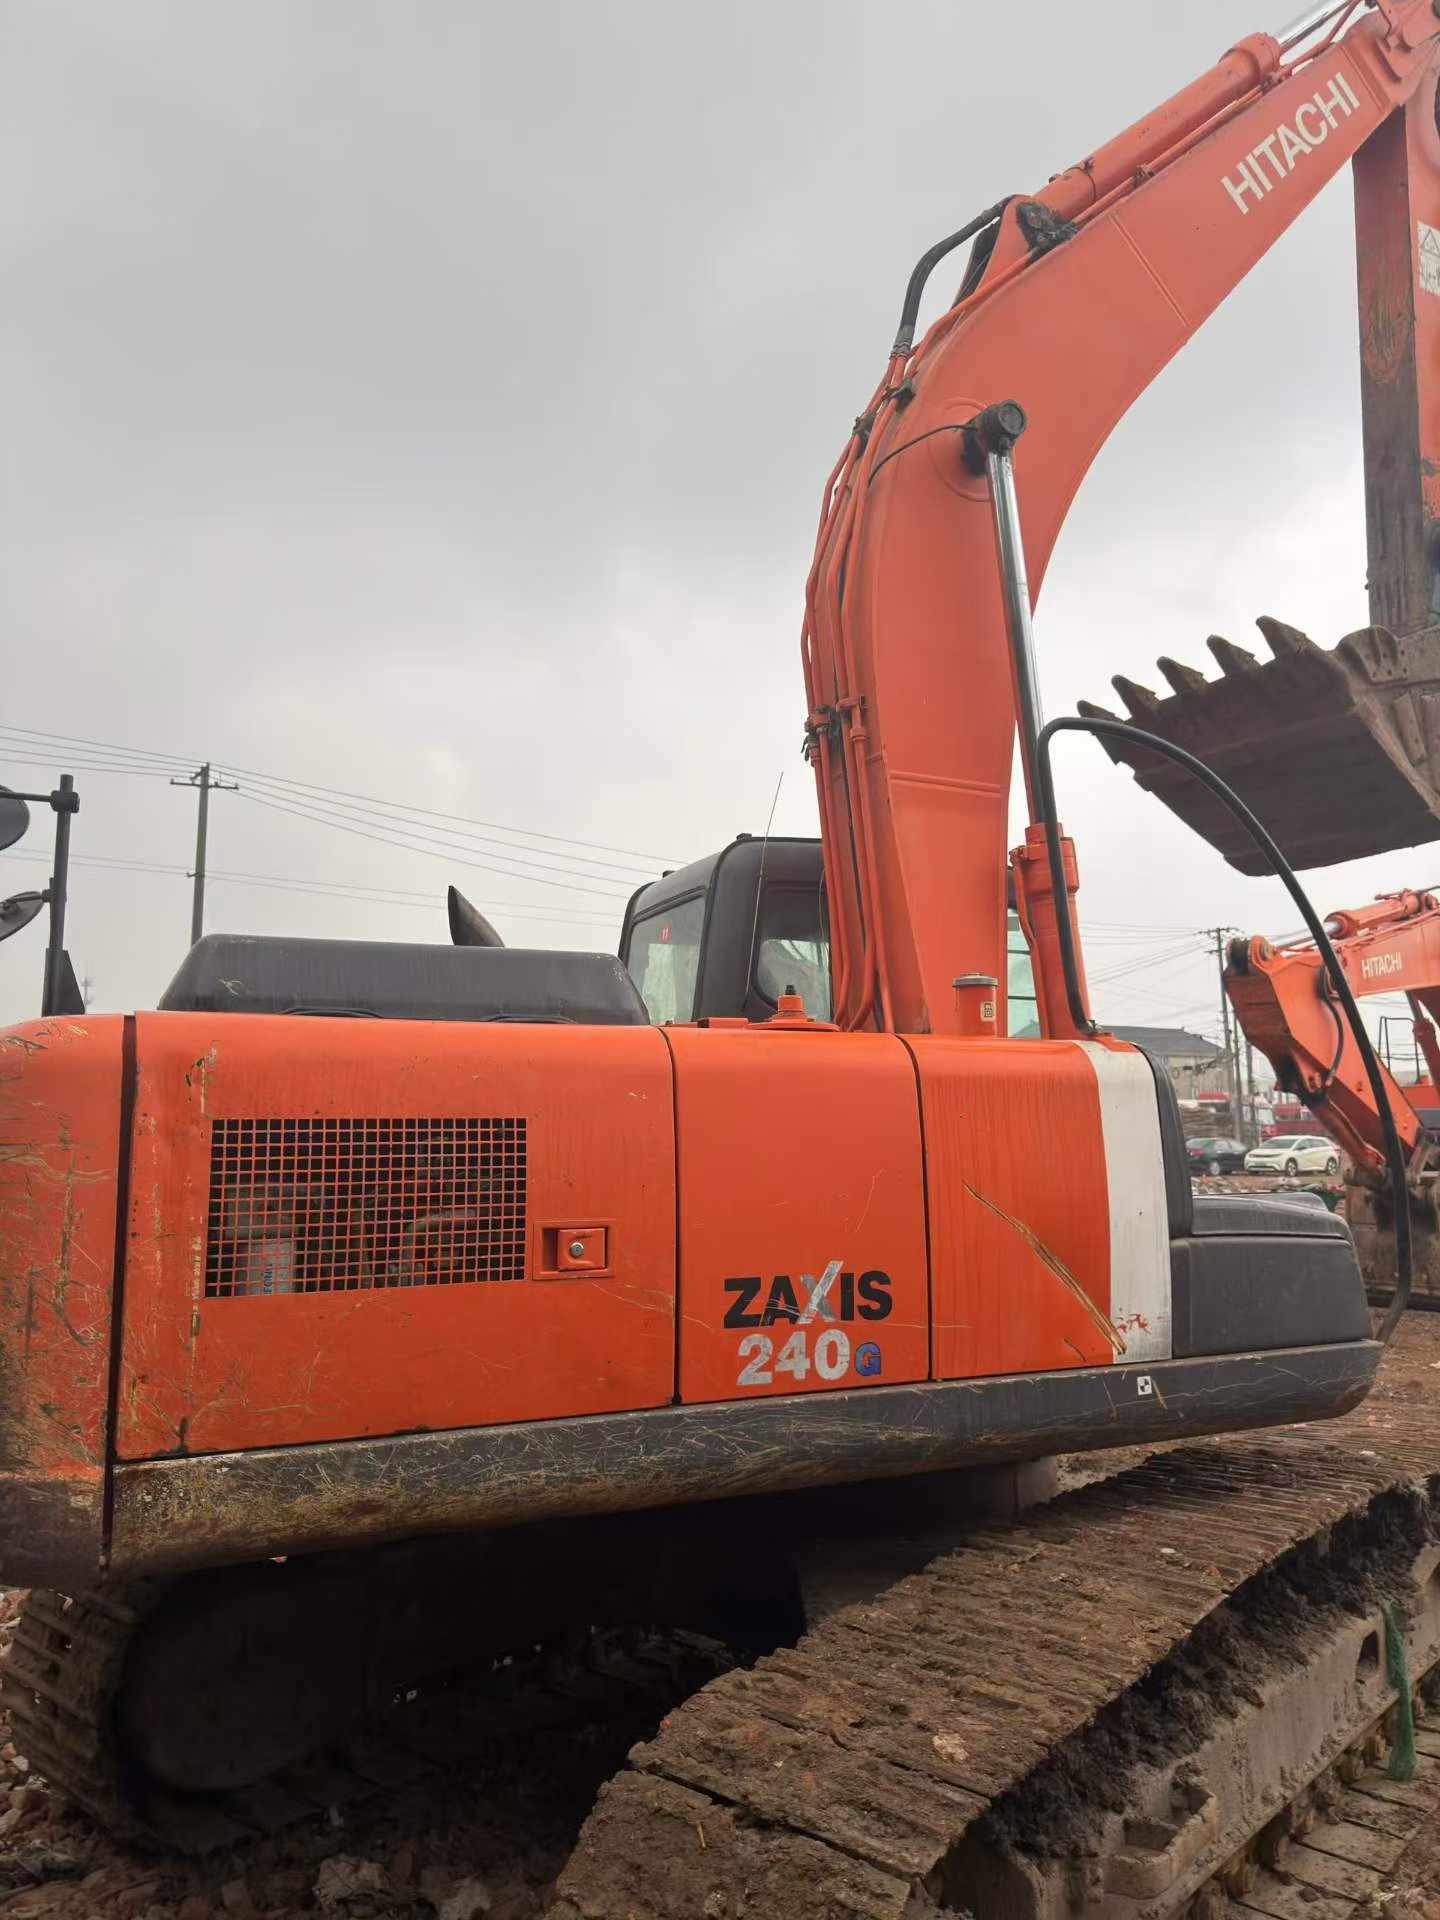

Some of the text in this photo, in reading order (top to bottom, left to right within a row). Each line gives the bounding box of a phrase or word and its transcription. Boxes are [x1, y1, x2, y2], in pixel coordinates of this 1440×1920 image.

[1220, 72, 1361, 215] HITACHI
[1361, 951, 1403, 980] HITACHI
[723, 1260, 893, 1329] ZAXIS
